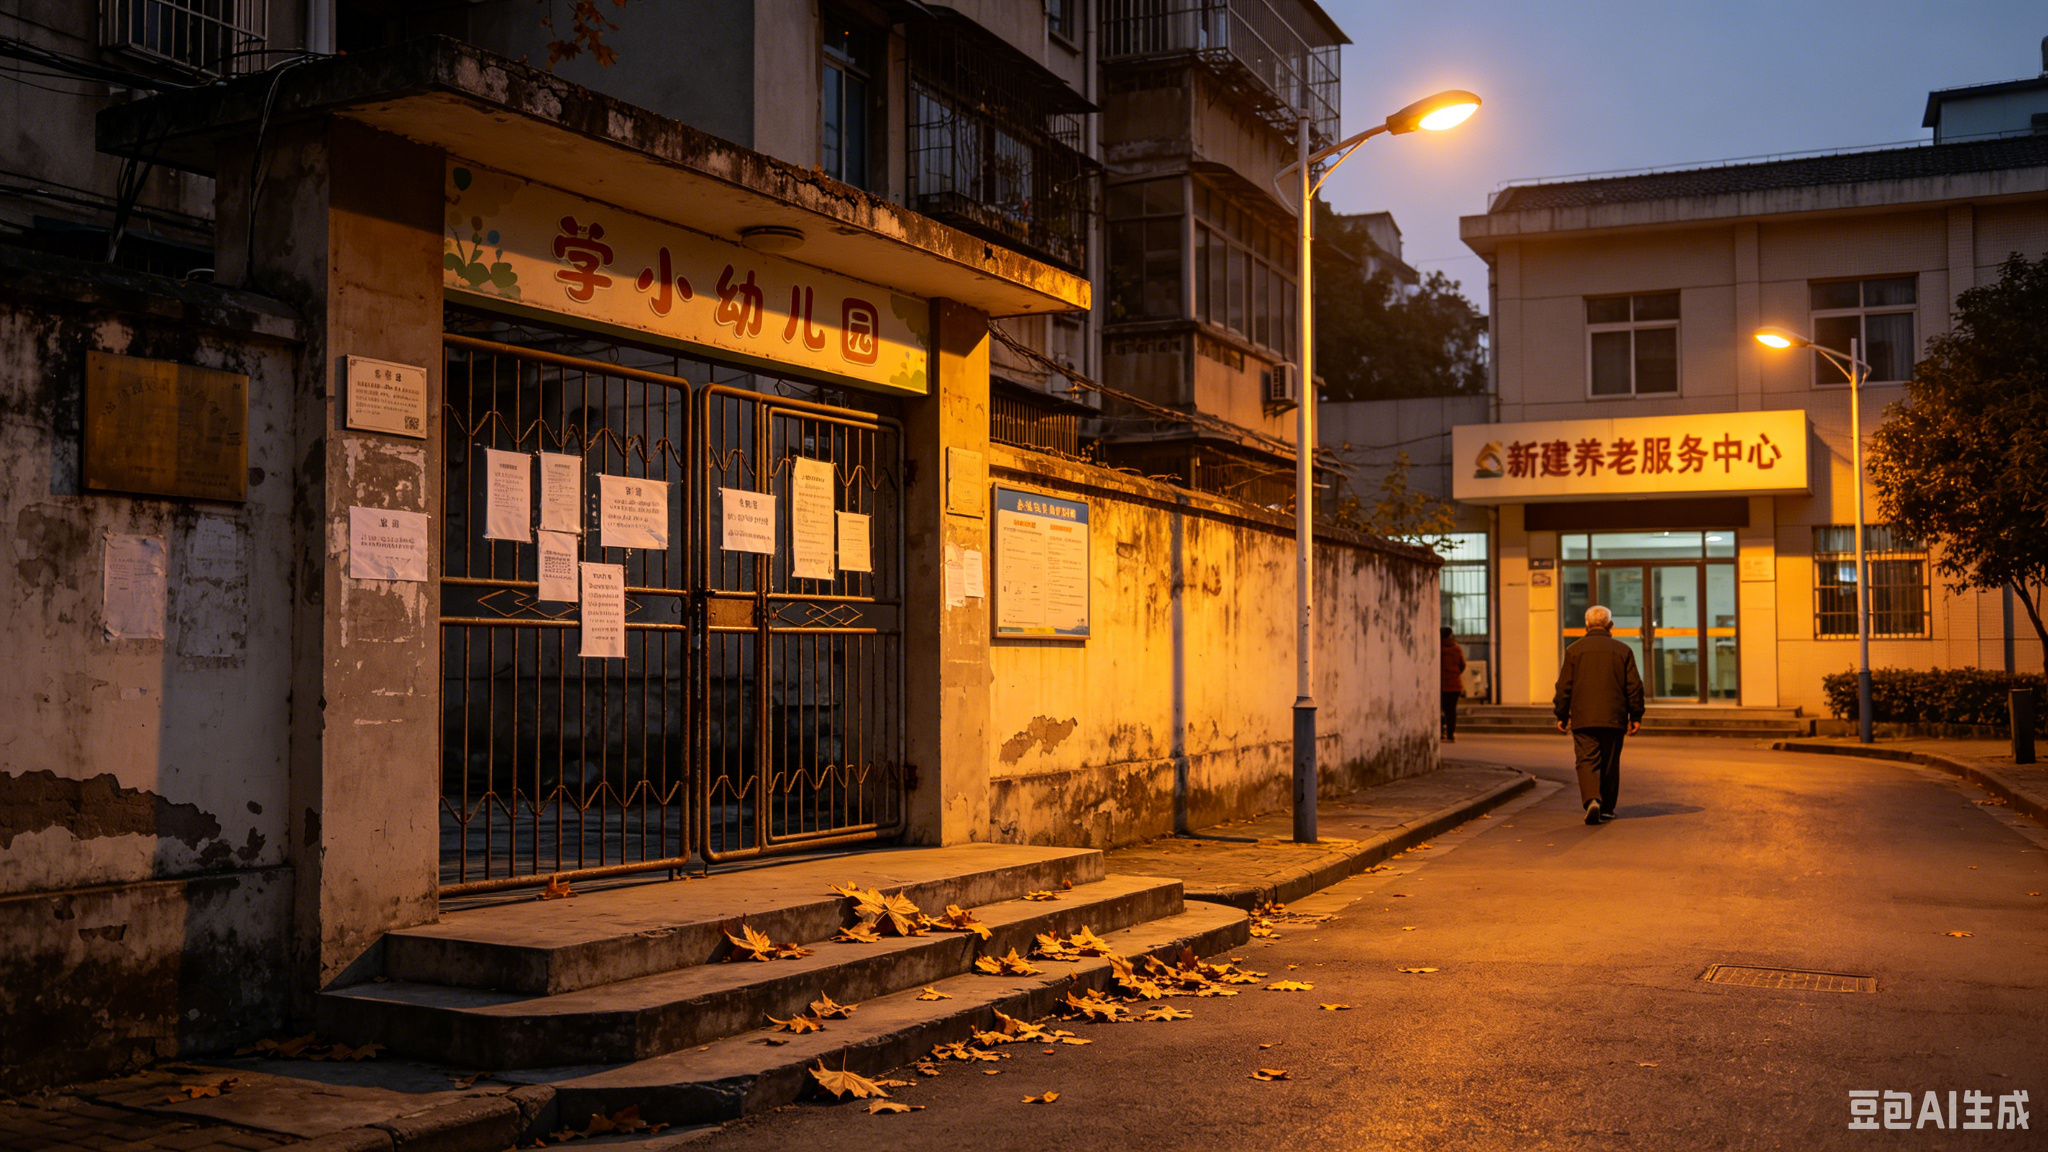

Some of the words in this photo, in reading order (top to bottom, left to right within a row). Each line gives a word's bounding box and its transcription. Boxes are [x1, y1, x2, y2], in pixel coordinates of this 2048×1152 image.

[553, 215, 879, 365] 学小幼儿园
[1506, 433, 1782, 479] 新建养老服务中心
